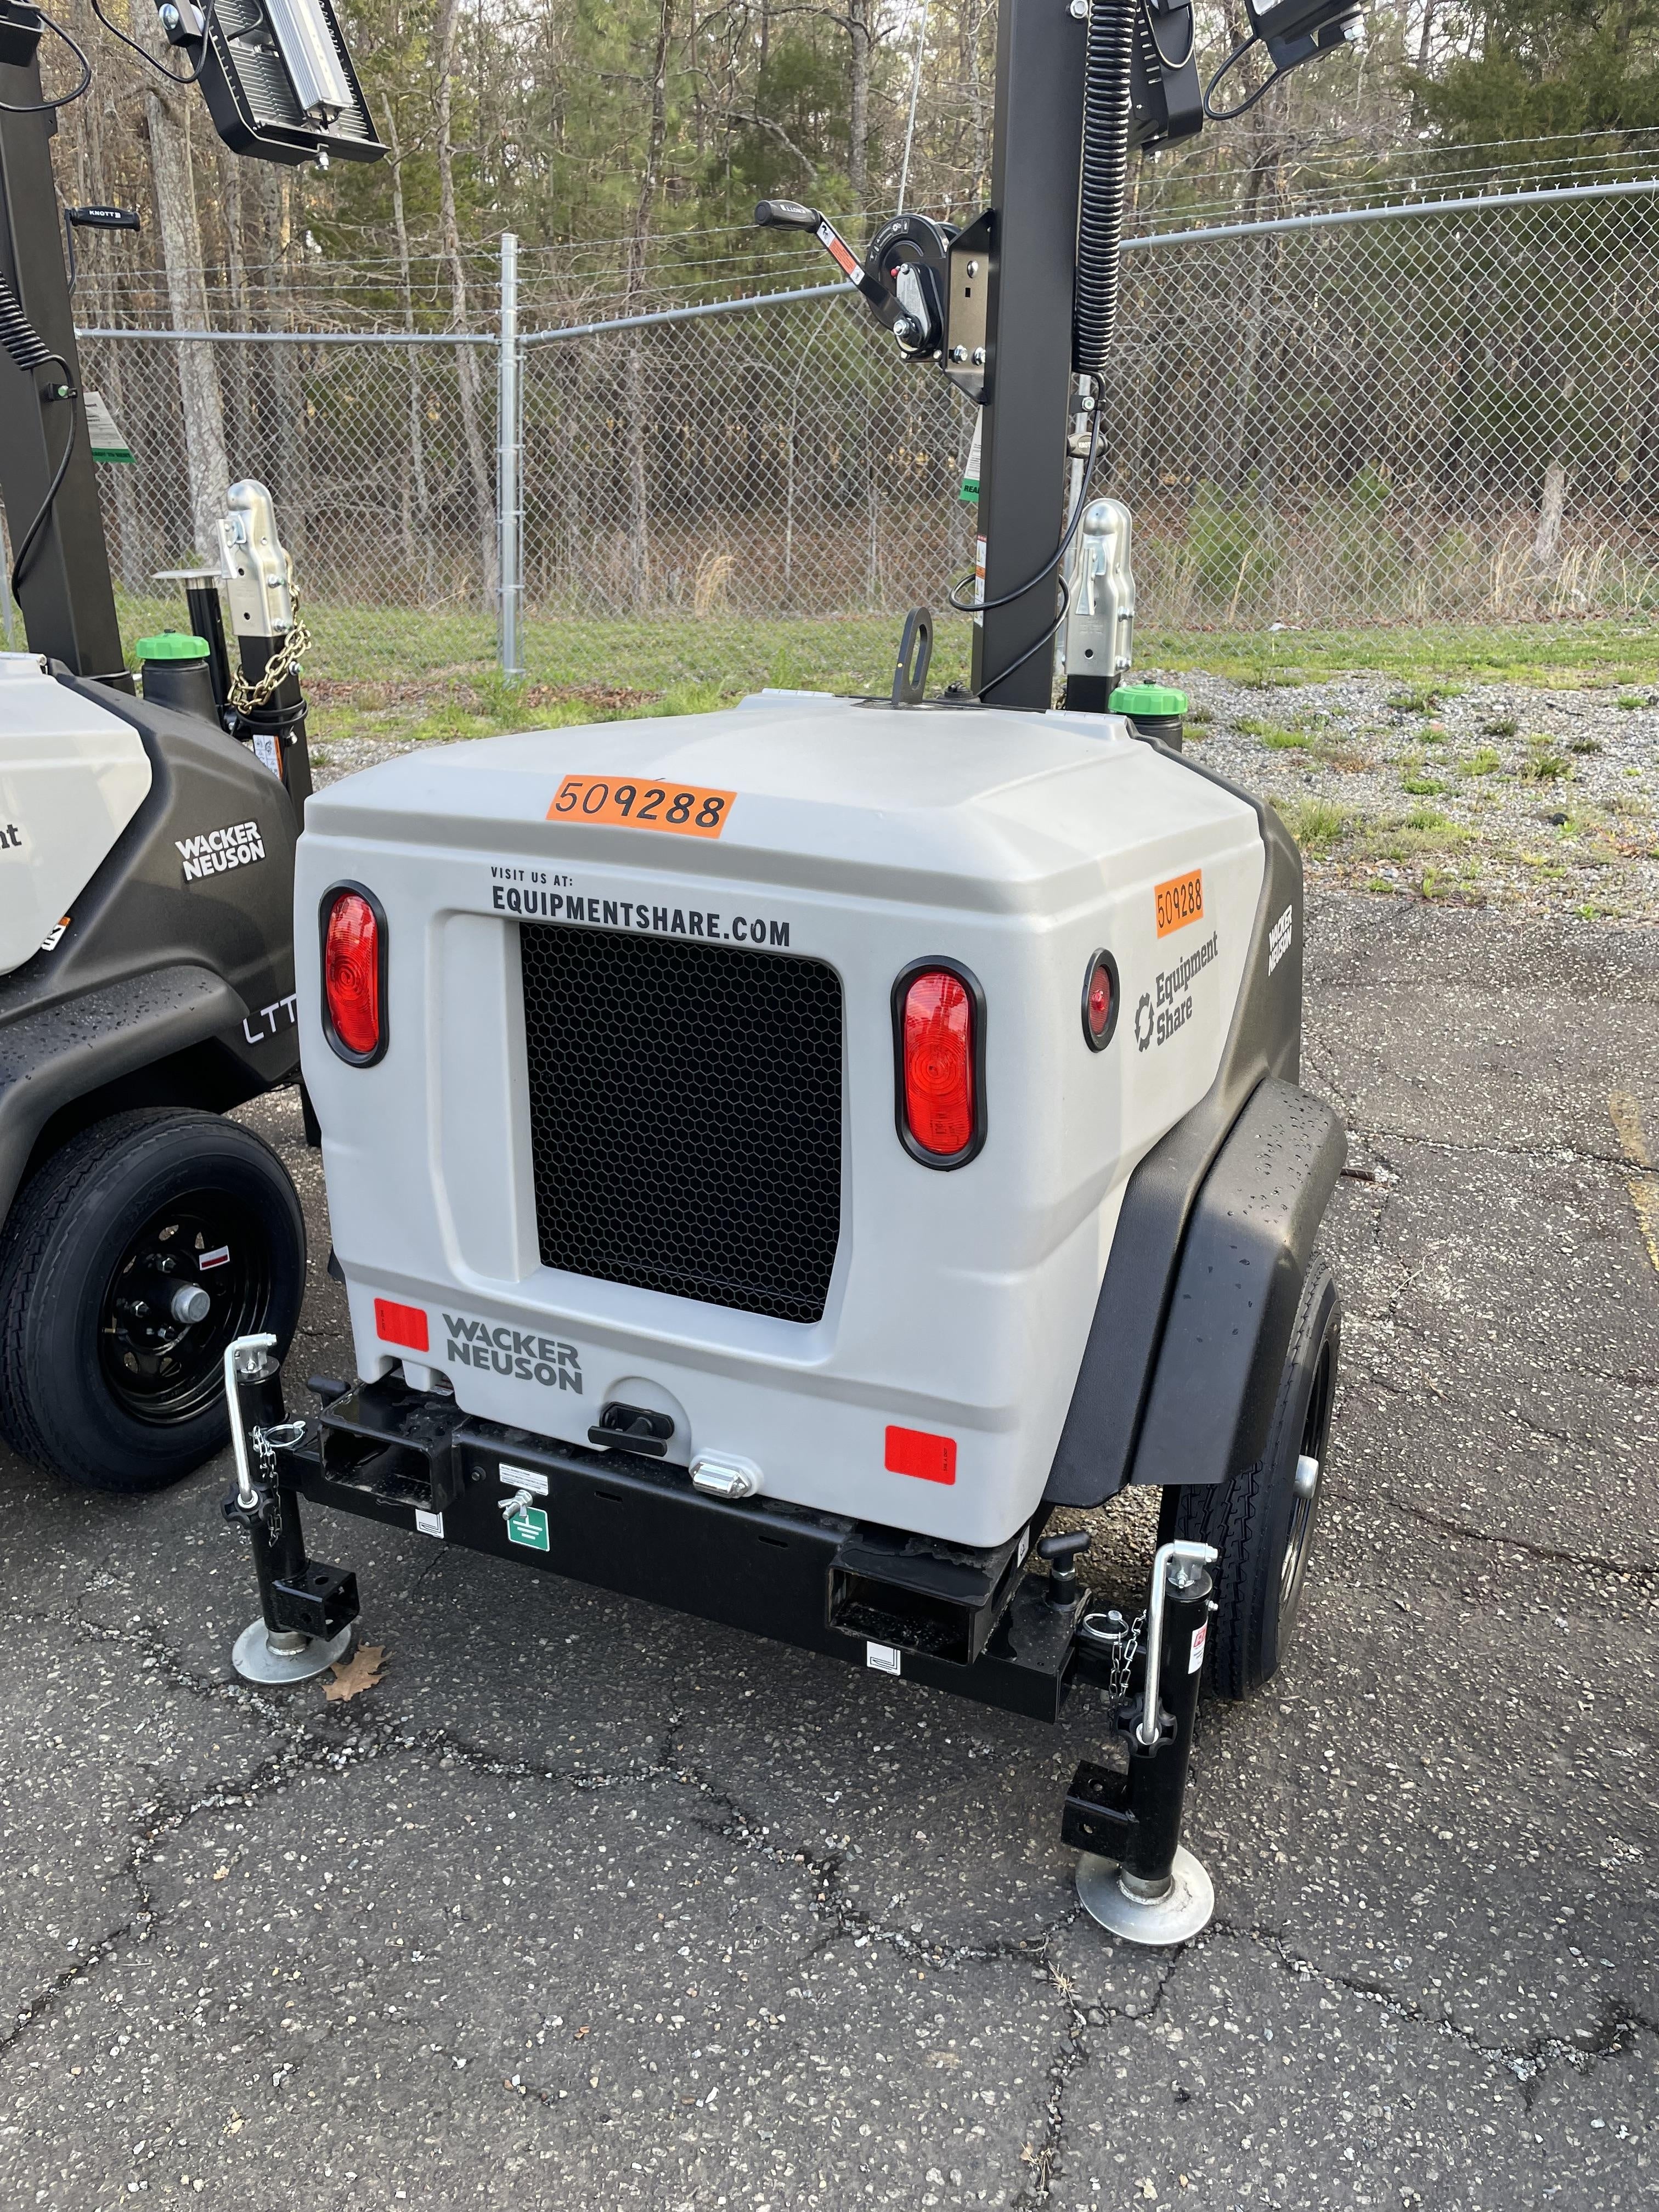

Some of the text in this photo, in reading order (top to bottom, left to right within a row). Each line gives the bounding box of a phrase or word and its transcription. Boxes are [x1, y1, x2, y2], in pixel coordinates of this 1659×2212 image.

[555, 782, 725, 828] 509288
[174, 821, 261, 860] WACKER
[182, 839, 266, 881] NEUSON
[491, 866, 573, 887] VISIT US AT:
[493, 885, 790, 947] EQUIPMENTSHARE.COM
[1158, 878, 1202, 928] 509288
[1268, 904, 1293, 952] WACKER
[1155, 930, 1218, 1008] Equipment
[1268, 924, 1292, 977] NEUSON
[1157, 995, 1192, 1046] Share
[442, 1313, 582, 1370] WACKER
[447, 1339, 583, 1395] NEUSON
